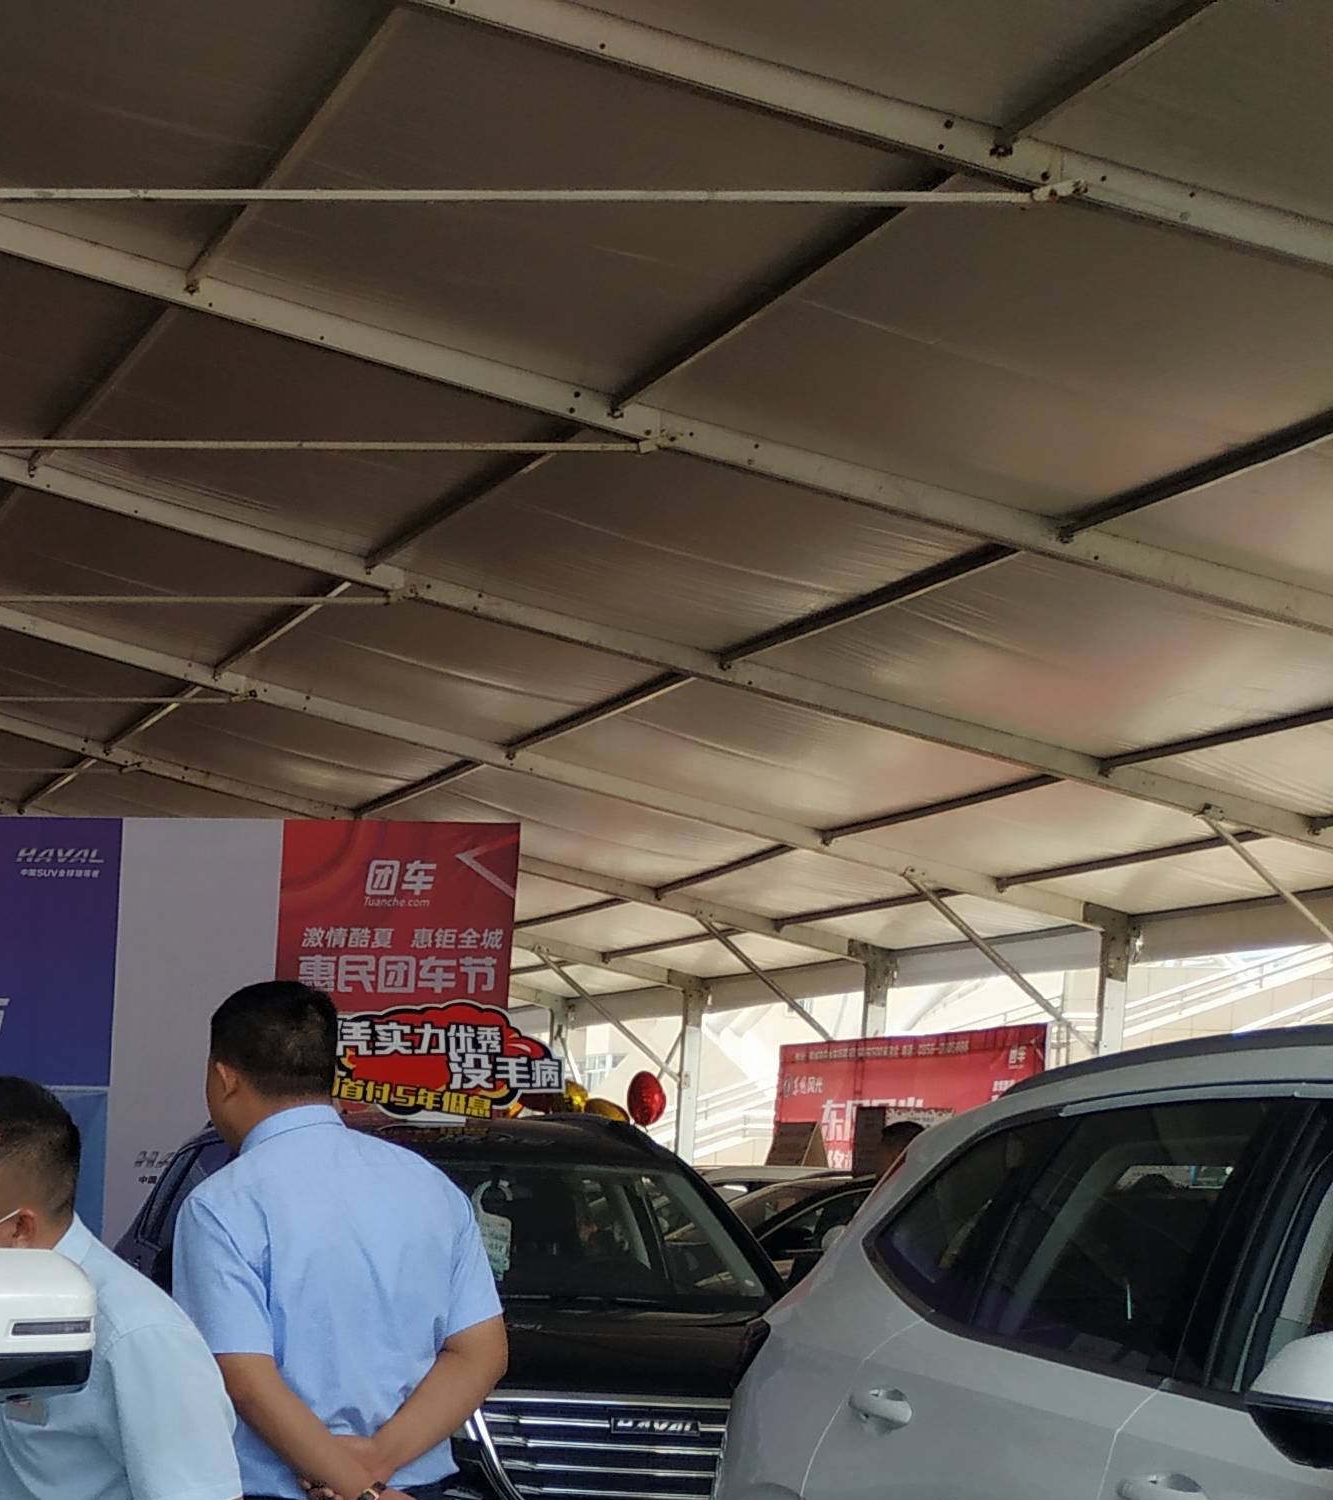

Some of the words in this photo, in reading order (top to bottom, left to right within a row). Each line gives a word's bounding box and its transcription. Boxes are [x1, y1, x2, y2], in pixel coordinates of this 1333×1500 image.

[15, 847, 105, 864] HAVAL
[365, 860, 437, 895] 团车
[301, 926, 395, 950] 激情酷夏
[297, 955, 497, 994] 惠民团车节
